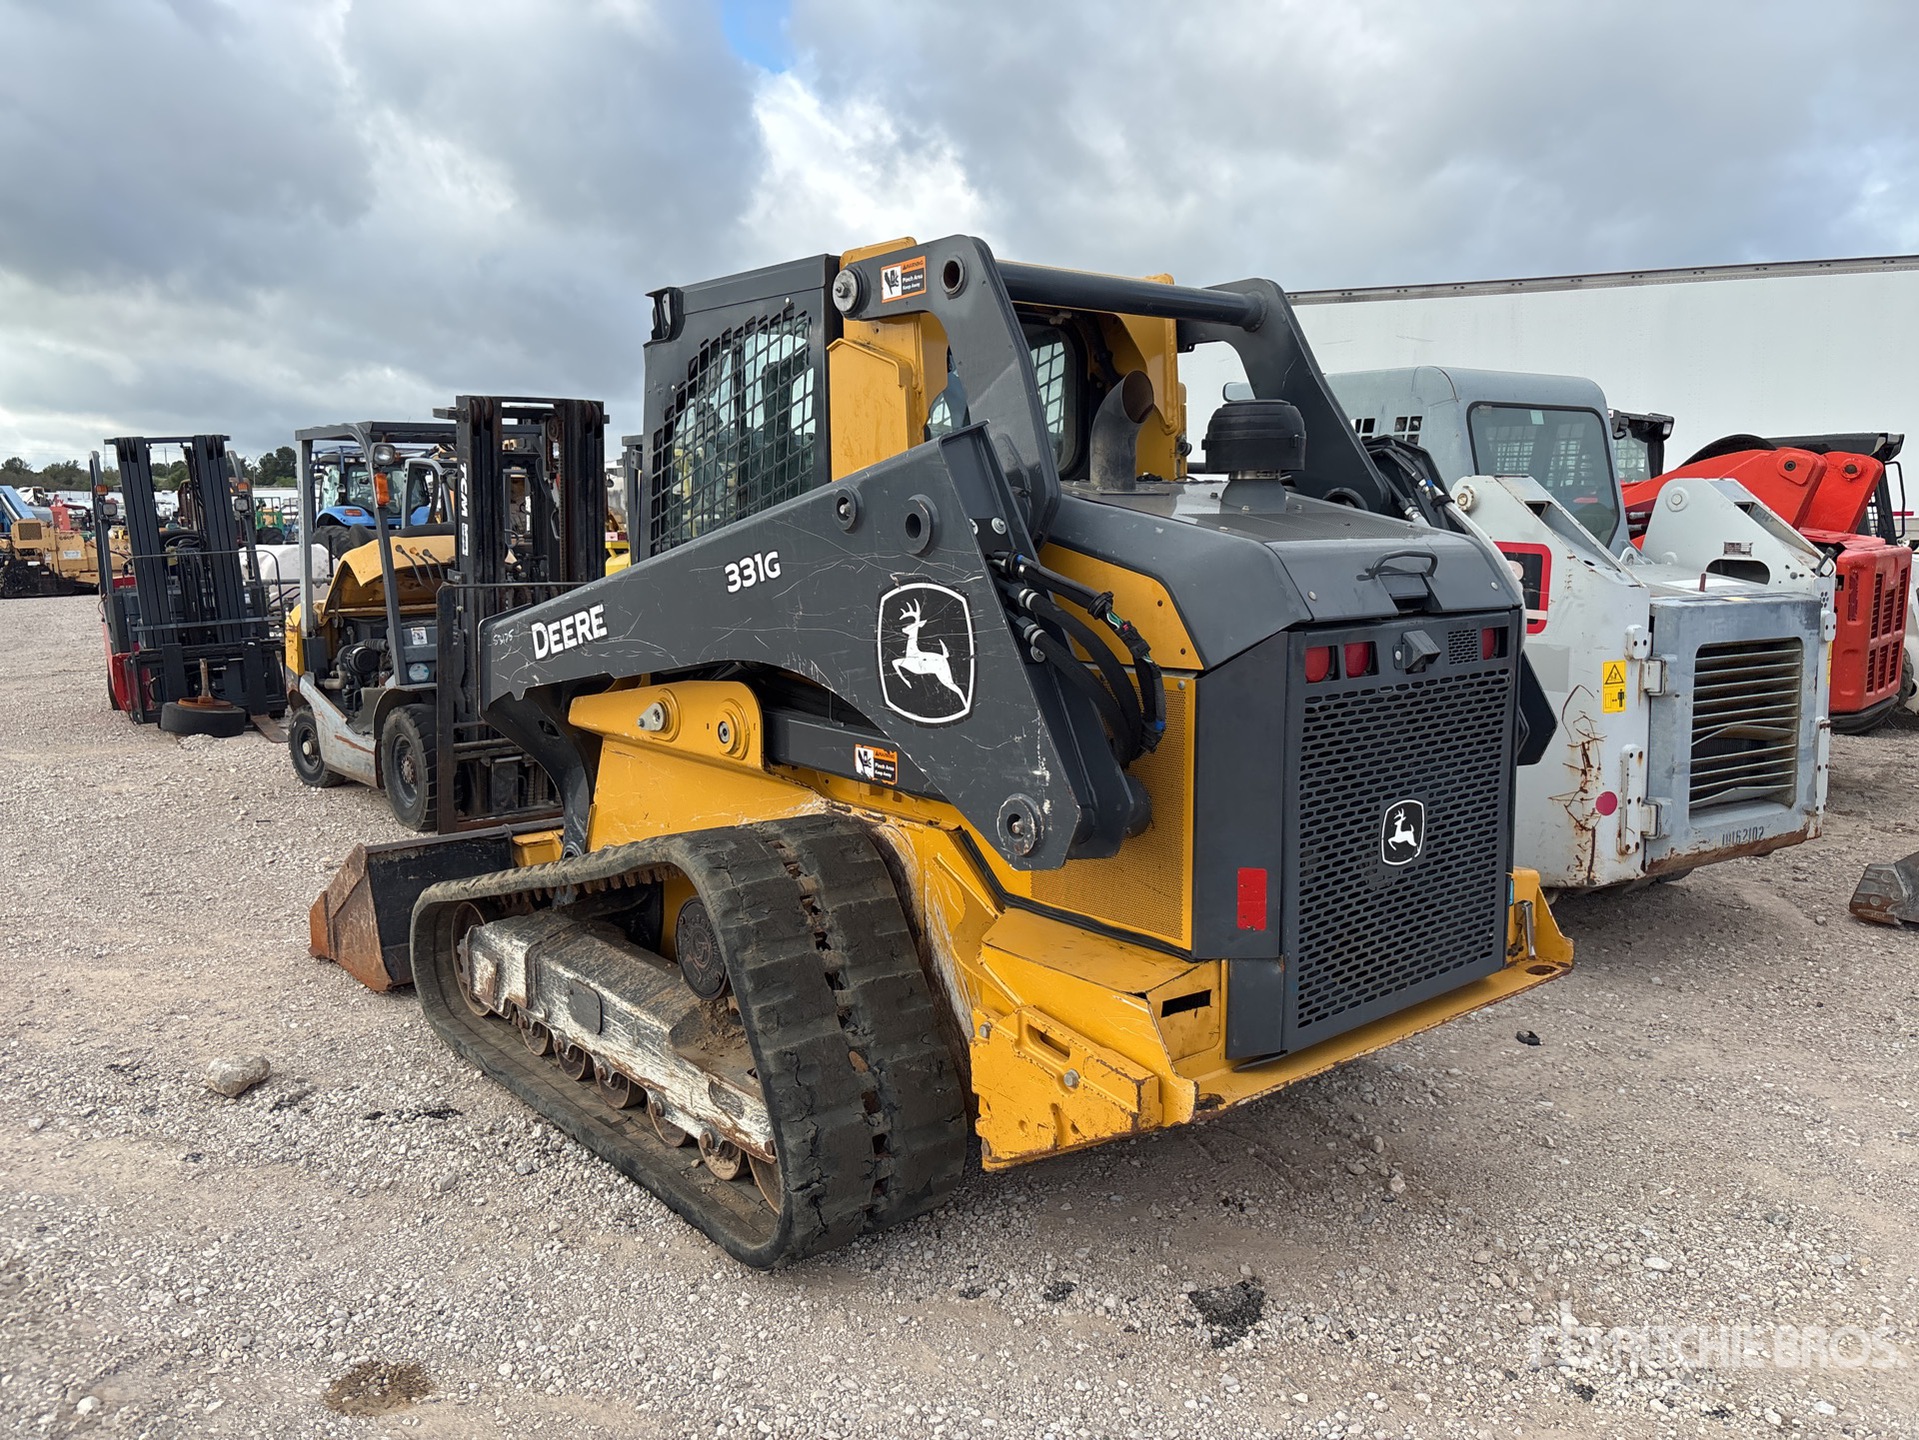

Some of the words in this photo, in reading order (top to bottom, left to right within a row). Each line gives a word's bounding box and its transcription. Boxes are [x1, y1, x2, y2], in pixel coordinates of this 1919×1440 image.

[460, 462, 469, 518] TCM
[724, 551, 781, 593] 331G
[531, 603, 608, 660] DEERE
